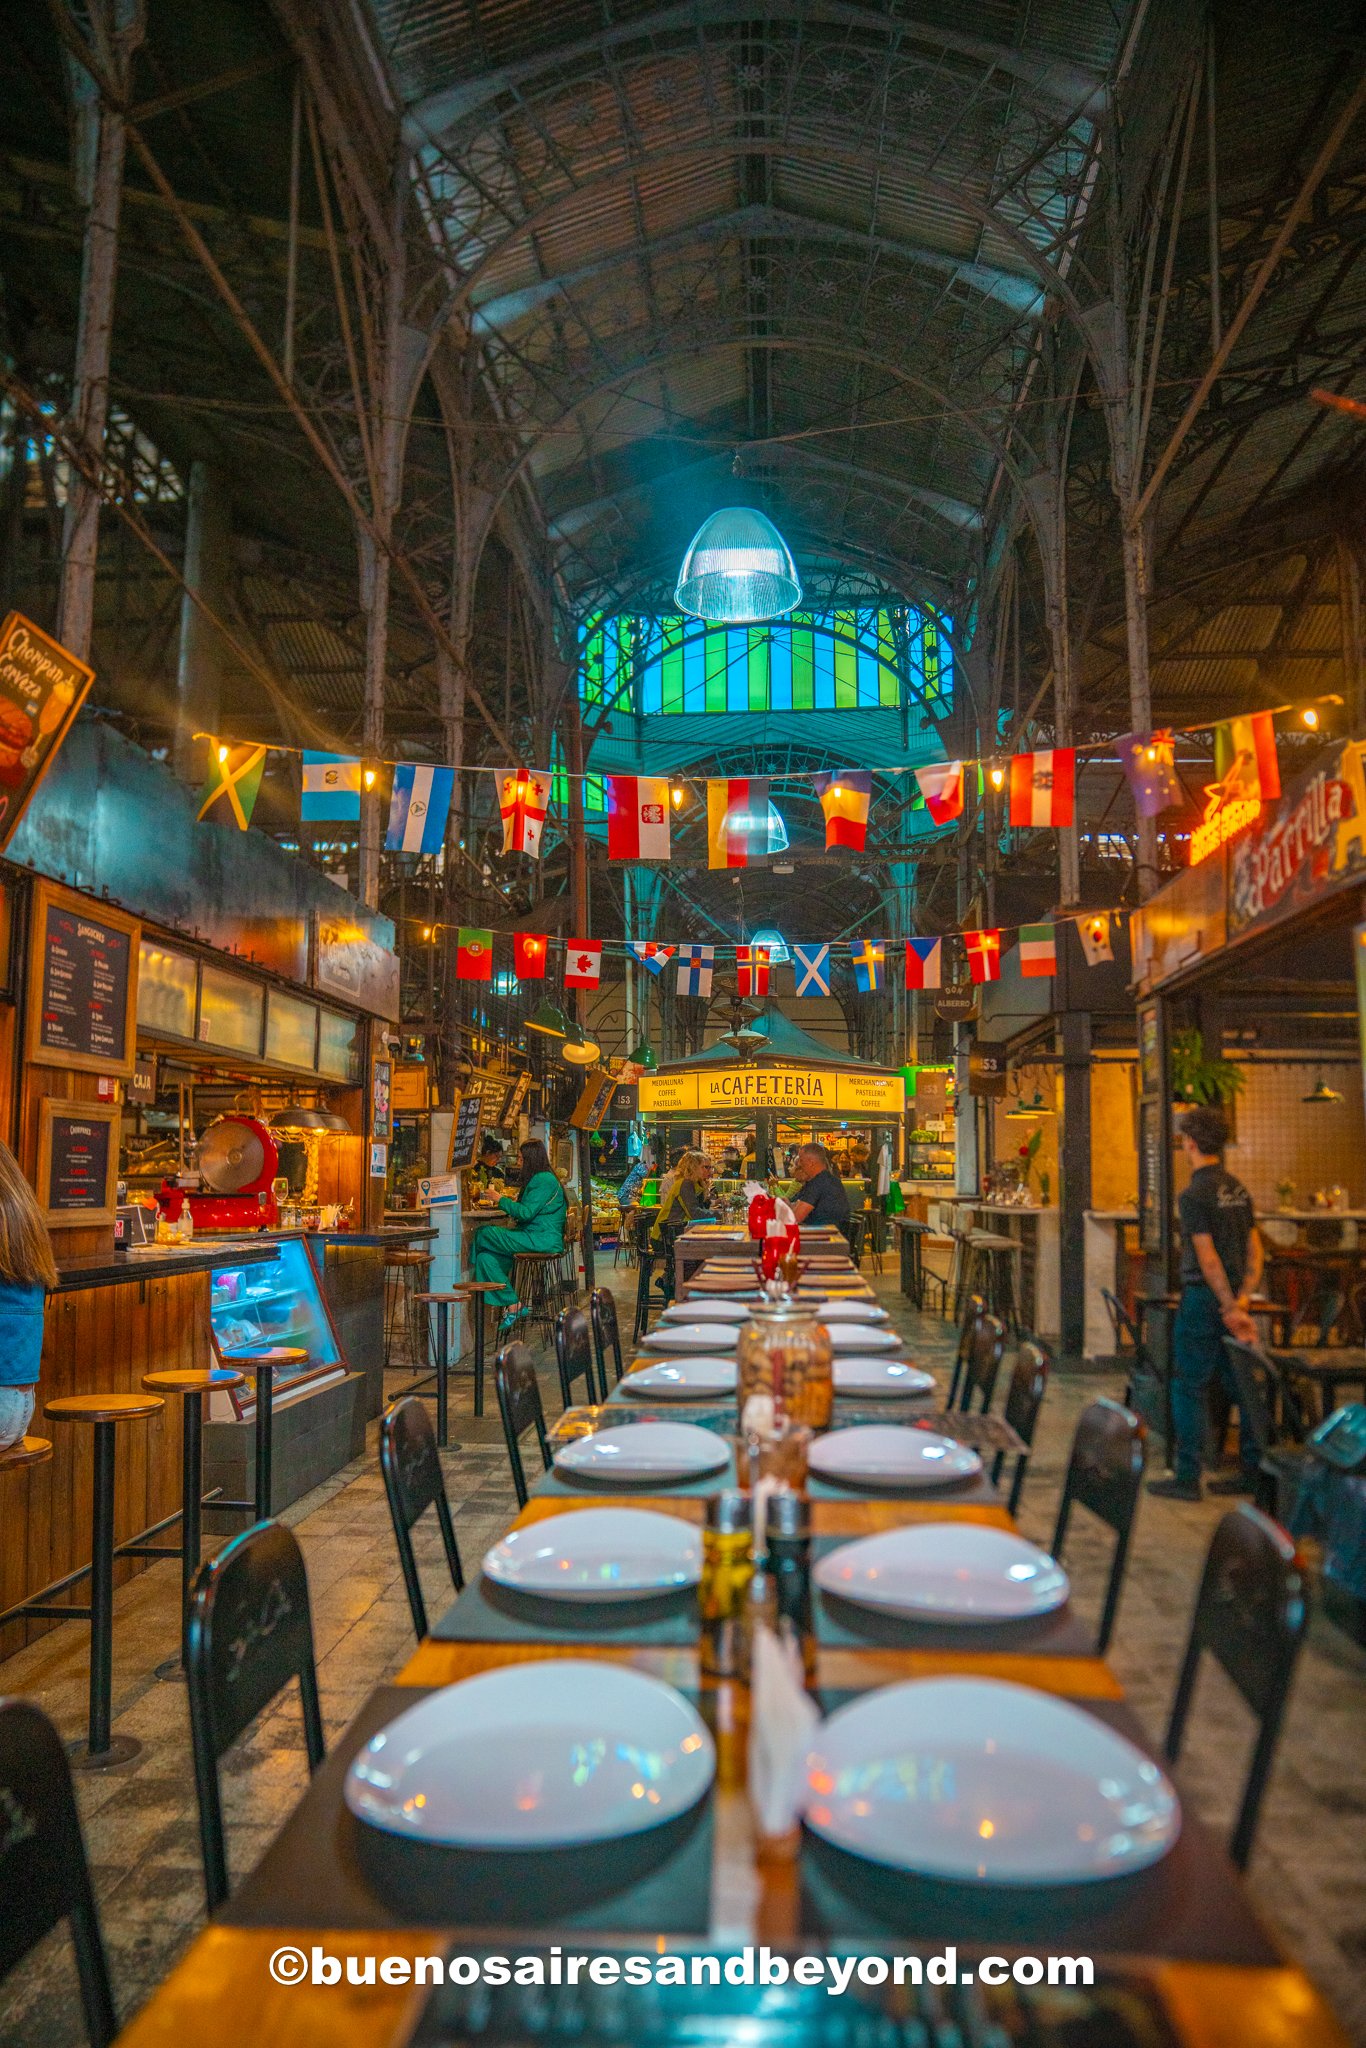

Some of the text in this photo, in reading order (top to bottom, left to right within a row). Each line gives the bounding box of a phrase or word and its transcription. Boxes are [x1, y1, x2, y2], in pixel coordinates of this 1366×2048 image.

[133, 1073, 151, 1090] CAJA
[651, 1078, 684, 1087] MEDIALUNAS
[710, 1073, 824, 1096] LA CAFETERÍA
[658, 1088, 677, 1097] COFFEE
[734, 1096, 799, 1106] DEL MERCADO
[861, 1099, 880, 1107] COFFEE
